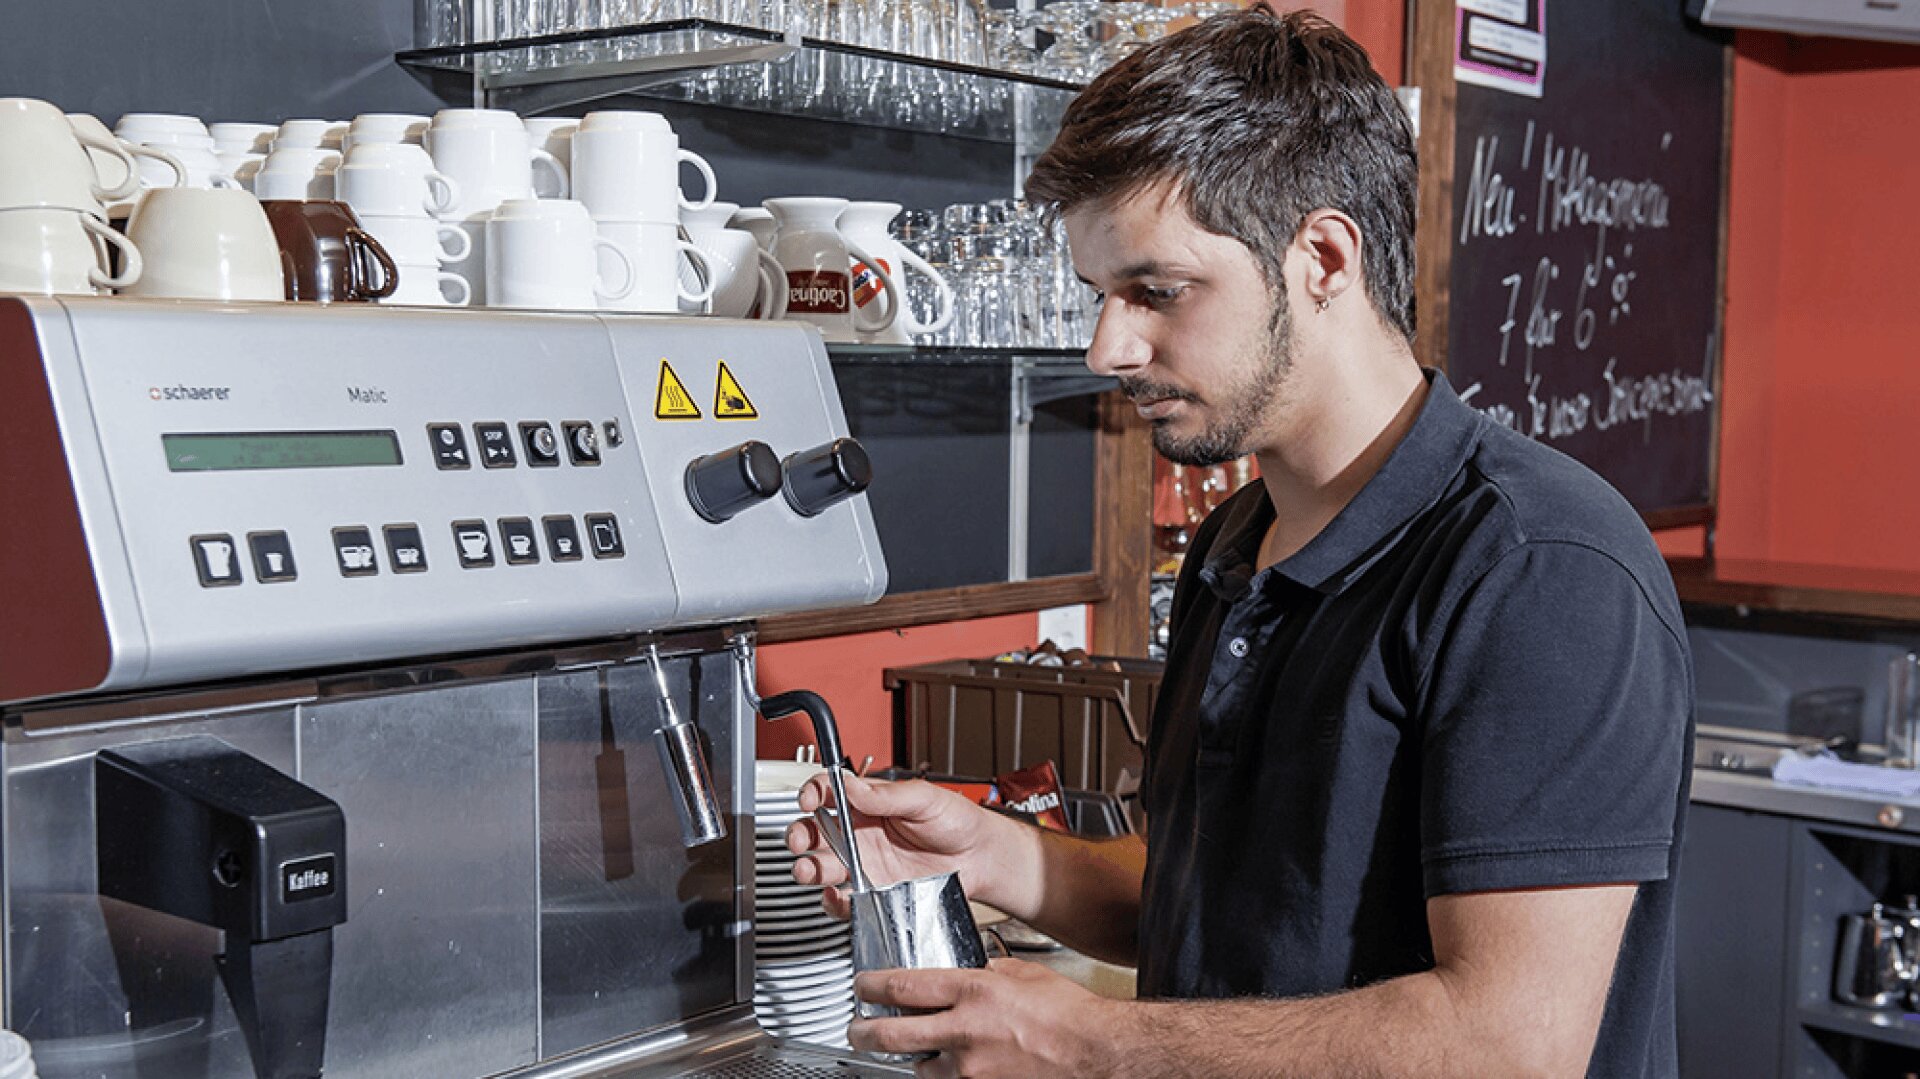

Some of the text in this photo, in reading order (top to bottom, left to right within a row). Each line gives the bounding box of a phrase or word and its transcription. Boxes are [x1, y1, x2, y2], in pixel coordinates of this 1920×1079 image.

[790, 287, 845, 309] Caotina
[1500, 273, 1521, 367] 7
[162, 383, 231, 400] schaerer
[346, 386, 388, 403] Matic
[288, 869, 329, 891] Kaffee
